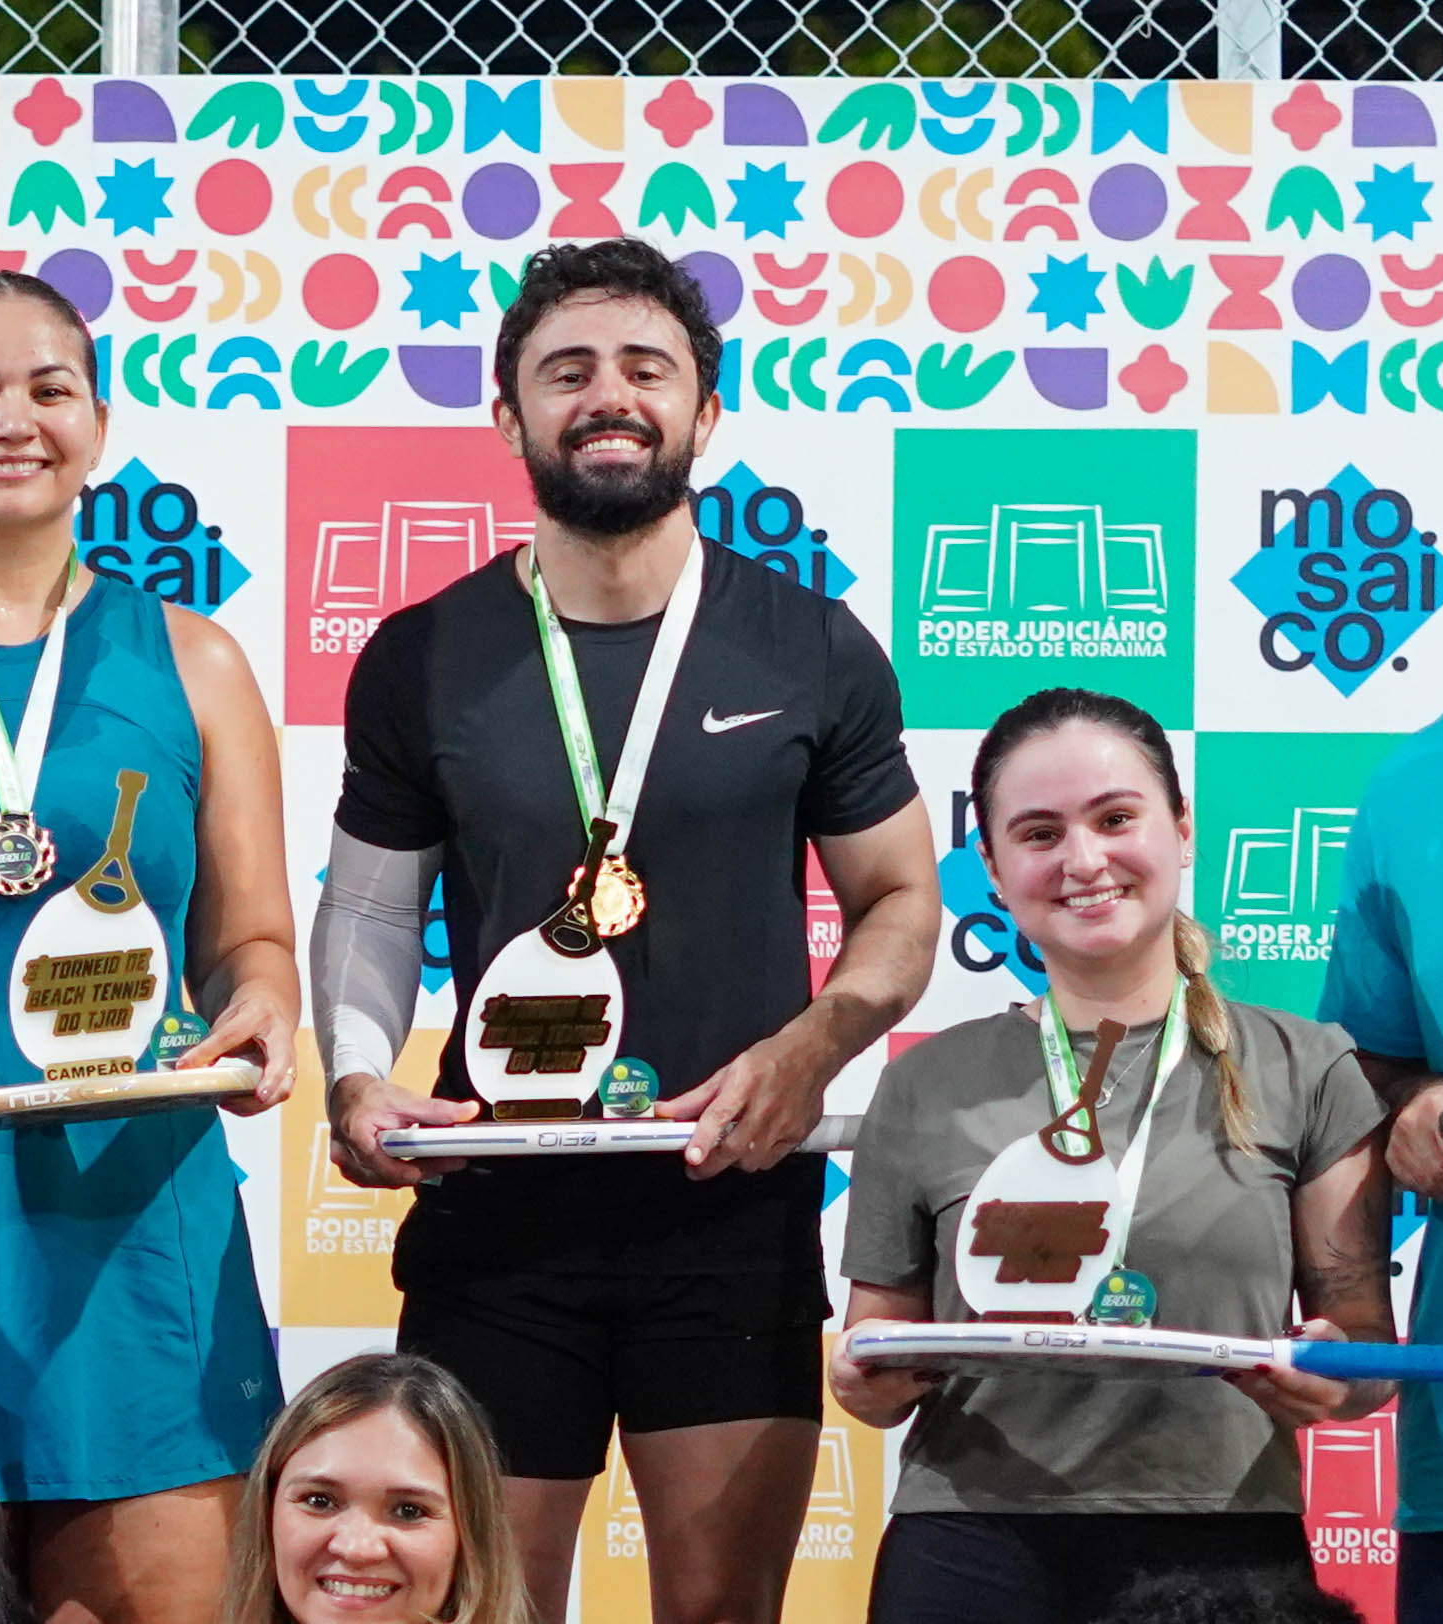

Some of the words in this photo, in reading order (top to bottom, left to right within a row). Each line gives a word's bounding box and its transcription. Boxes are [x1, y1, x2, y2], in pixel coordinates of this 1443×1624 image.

[1295, 529, 1437, 612] sai
[918, 619, 1011, 642] PODER
[1015, 615, 1167, 642] JUDICIÁRIO
[310, 637, 343, 654] DO
[918, 640, 951, 657] DO
[955, 640, 1035, 657] ESTADO
[1038, 640, 1067, 657] DE
[1071, 640, 1167, 657] RORAIMA
[1221, 924, 1311, 945] PODER
[1221, 944, 1251, 961] DO
[50, 955, 121, 981] TORNEIO
[125, 952, 149, 973] DE
[30, 986, 86, 1008] BEACH
[91, 978, 152, 1003] TENNIS
[46, 1059, 134, 1082] CAMPEÃO
[306, 1217, 396, 1239] PODER
[306, 1238, 336, 1255] DO
[608, 1543, 639, 1560] DO
[1336, 1548, 1361, 1564] DE
